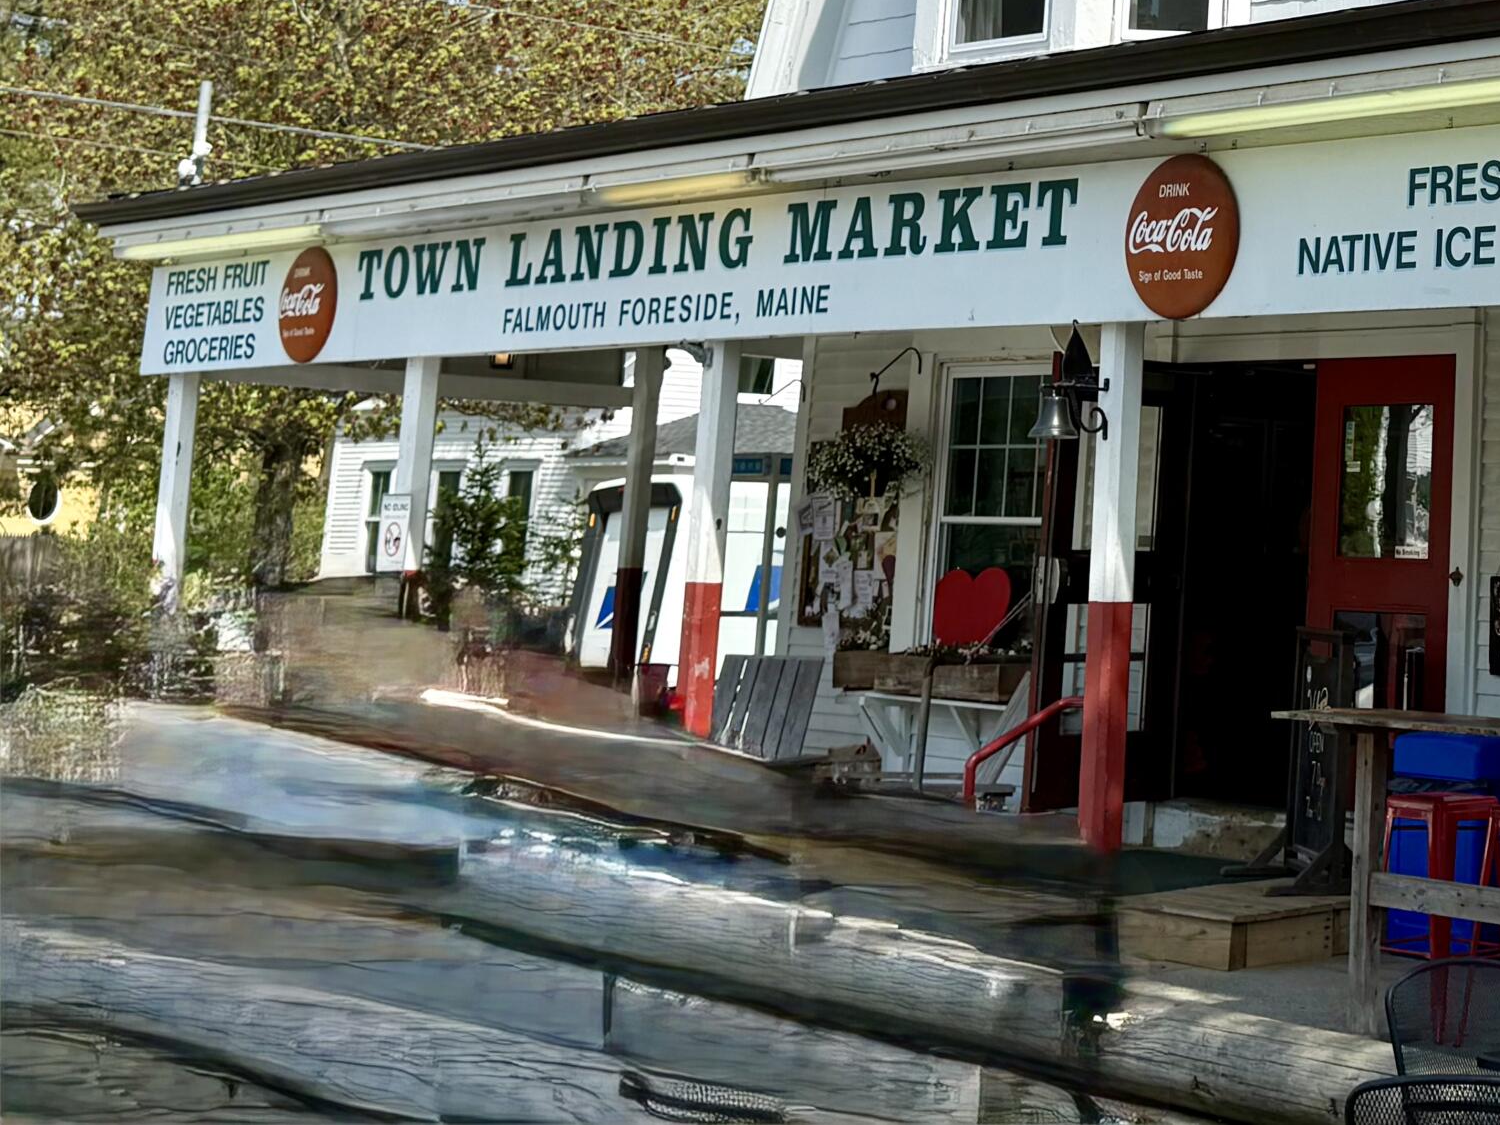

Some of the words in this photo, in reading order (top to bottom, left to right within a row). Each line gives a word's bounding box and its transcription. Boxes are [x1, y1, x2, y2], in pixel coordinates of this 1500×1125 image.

[1159, 182, 1191, 198] DRINK
[358, 236, 487, 301] TOWN
[504, 207, 754, 288] LANDING
[783, 177, 1079, 265] MARKET
[1128, 206, 1219, 255] Coca-Cola
[1298, 230, 1418, 275] NATIVE
[1434, 225, 1497, 269] ICE
[166, 266, 218, 296] FRESH
[222, 259, 270, 290] FRUIT
[1138, 270, 1152, 284] Sign
[1153, 270, 1161, 281] of
[1162, 269, 1182, 281] Good
[1184, 268, 1203, 280] Taste
[165, 296, 265, 330] VEGETABLES
[503, 300, 606, 334] FALMOUTH
[618, 292, 740, 327] FORESIDE,
[756, 284, 830, 318] MAINE
[163, 333, 256, 365] GROCERIES
